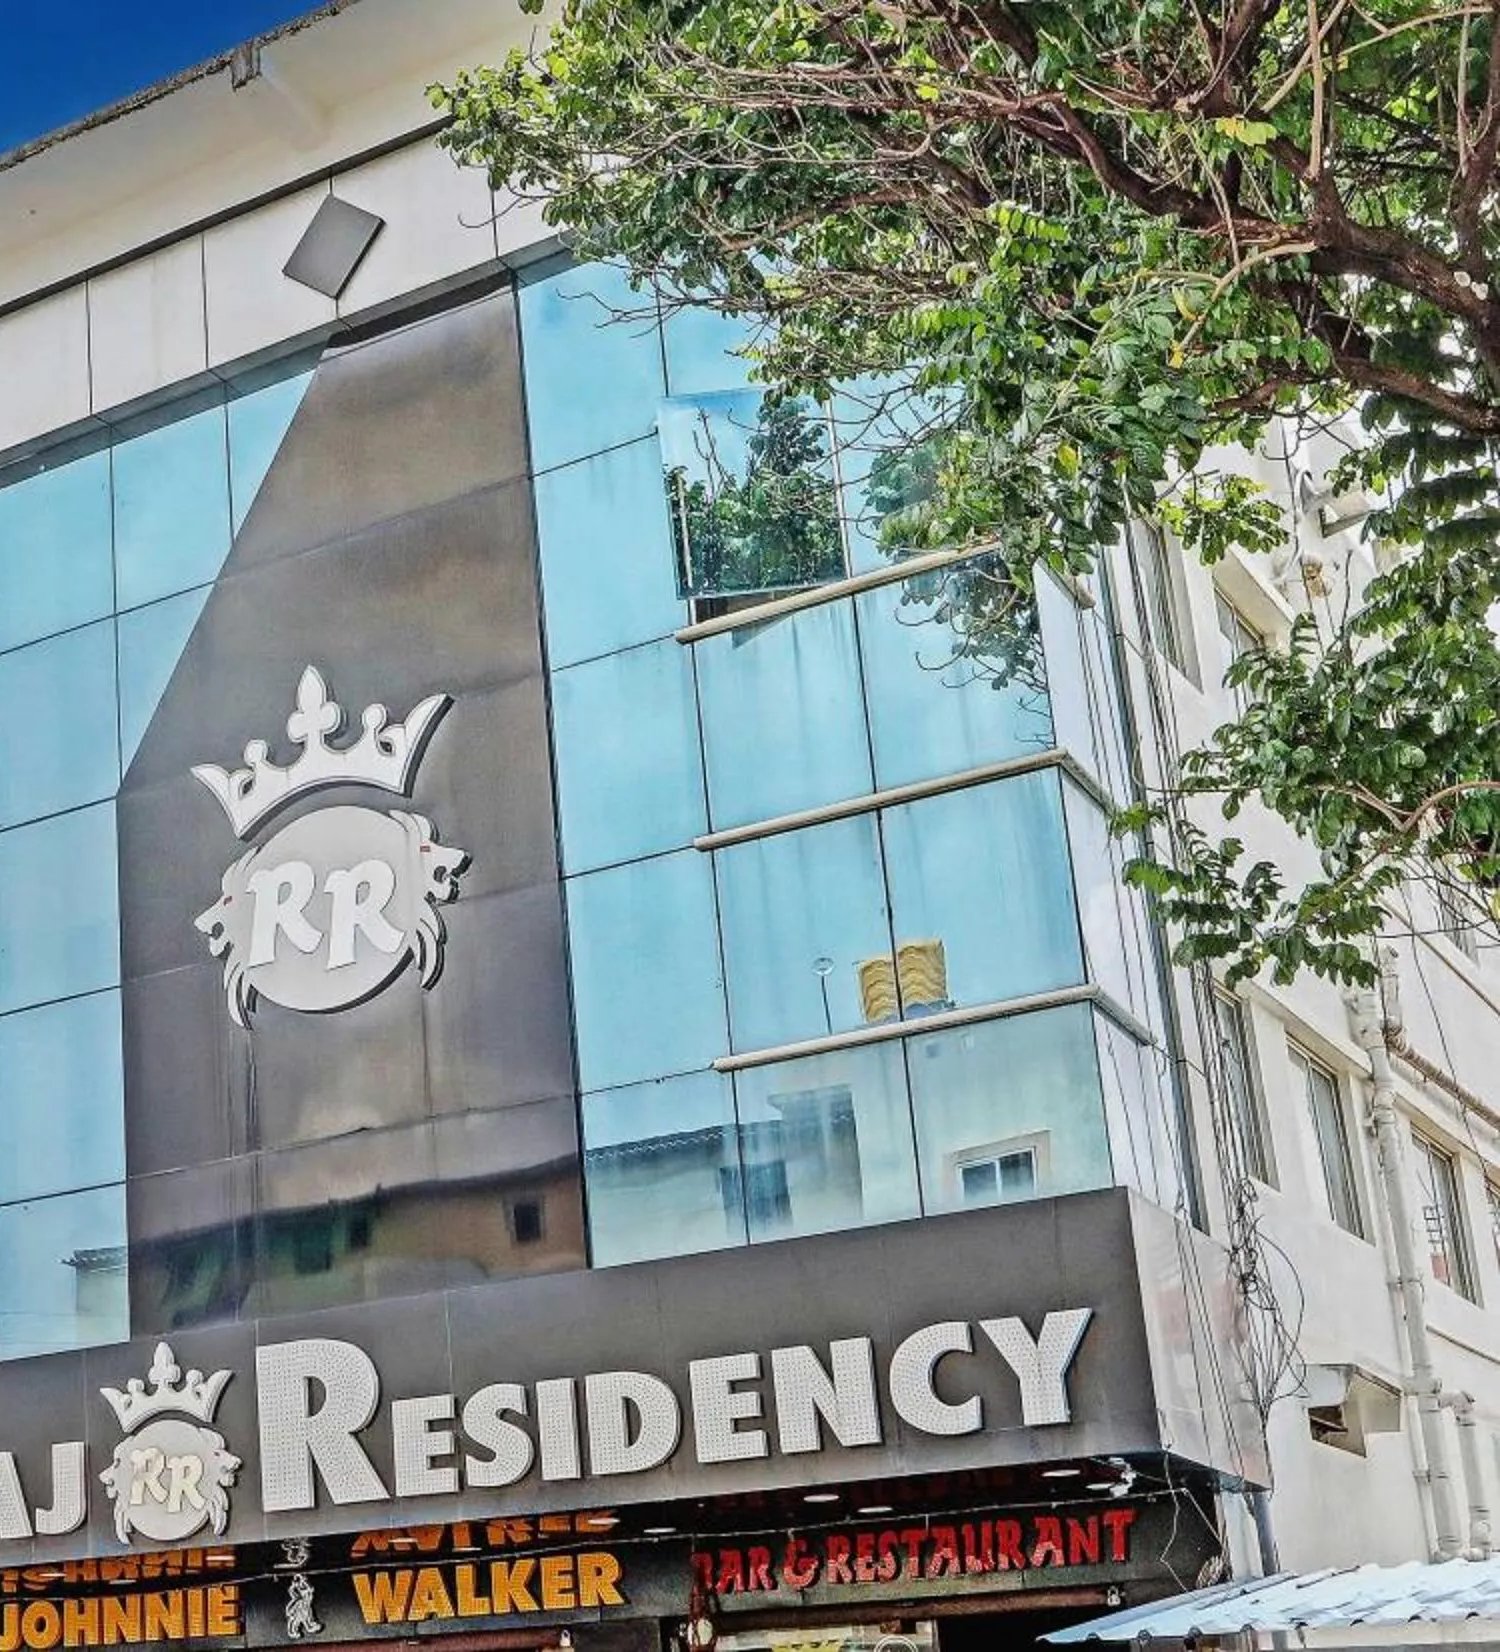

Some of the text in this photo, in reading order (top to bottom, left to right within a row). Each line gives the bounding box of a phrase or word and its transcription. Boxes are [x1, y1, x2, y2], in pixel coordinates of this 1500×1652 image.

[246, 859, 404, 970] RR
[129, 1447, 206, 1512] RR
[256, 1308, 1094, 1512] RESIDENCY
[352, 1552, 624, 1623] WALKER
[783, 1538, 821, 1590] &
[826, 1509, 1137, 1584] RESTAURANT
